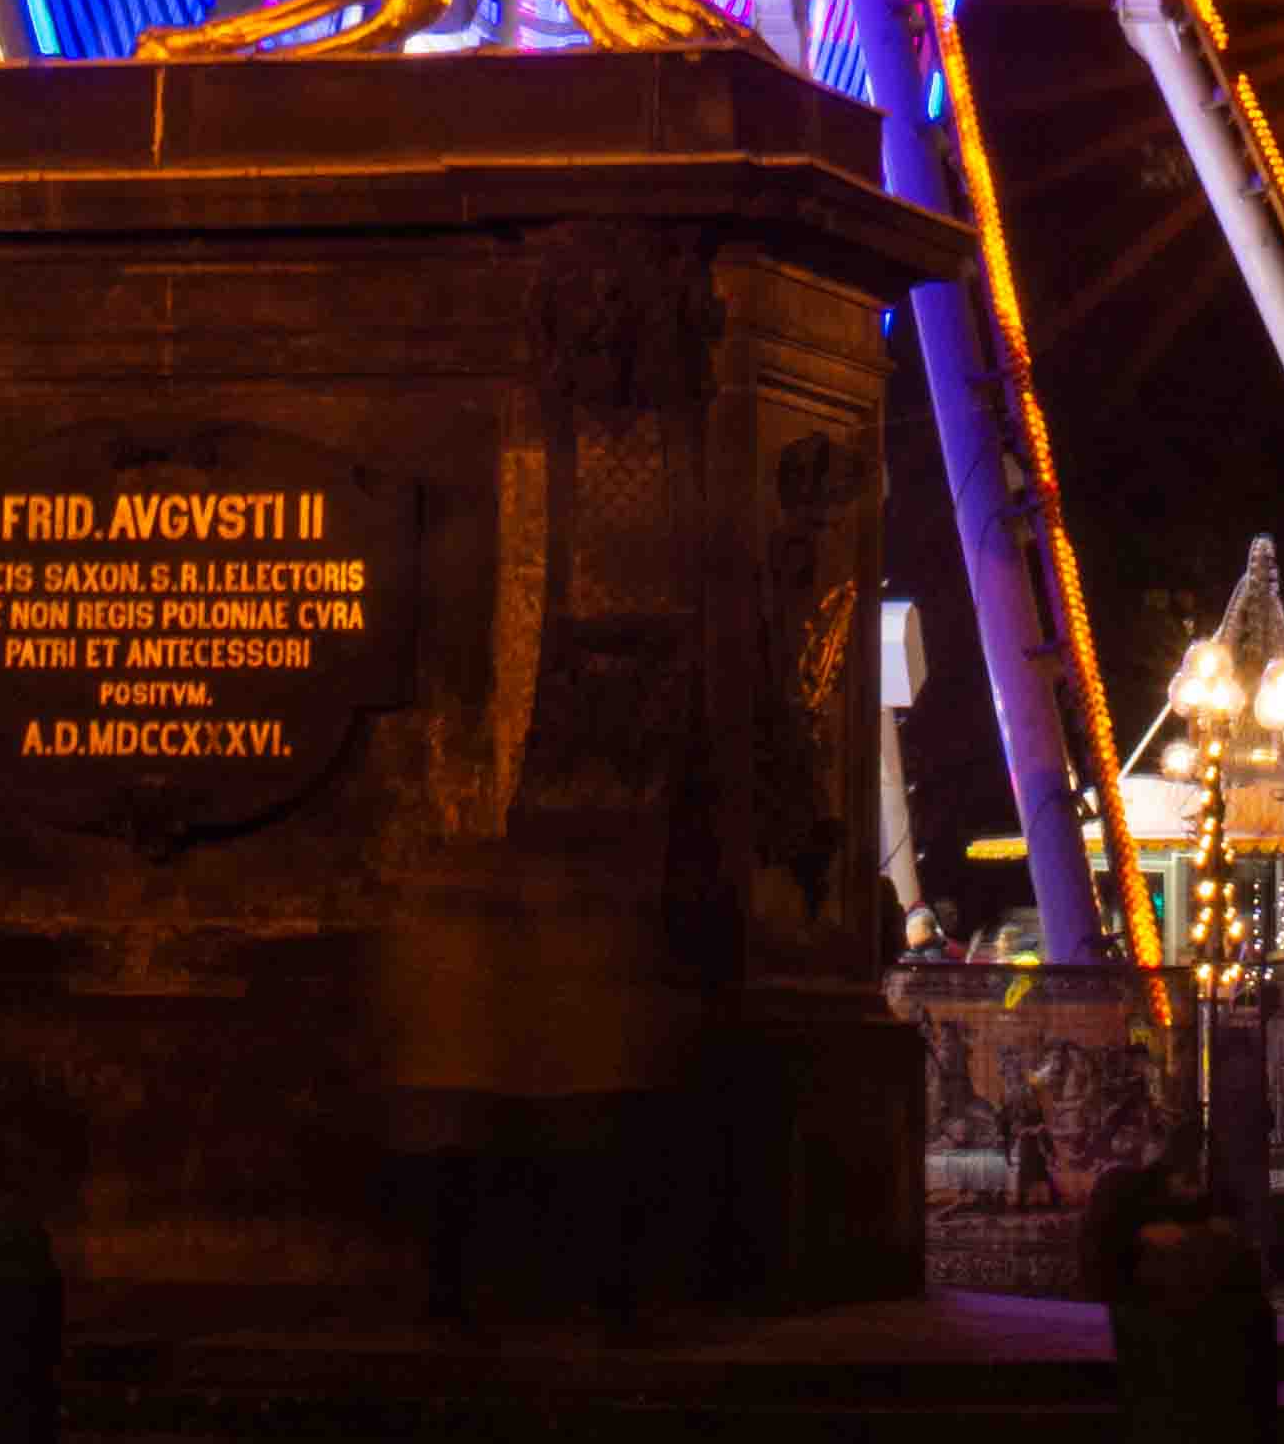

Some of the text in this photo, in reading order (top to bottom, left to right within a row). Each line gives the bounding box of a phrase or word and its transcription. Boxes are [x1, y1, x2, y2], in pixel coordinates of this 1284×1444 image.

[298, 492, 325, 540] II
[10, 599, 70, 630] NON
[76, 599, 155, 630] REGIS
[162, 599, 289, 630] POLONIAE
[298, 599, 365, 630] CVRA
[5, 637, 310, 668] PATRI ET ANTECESSORI
[100, 680, 213, 707] POSITVM.
